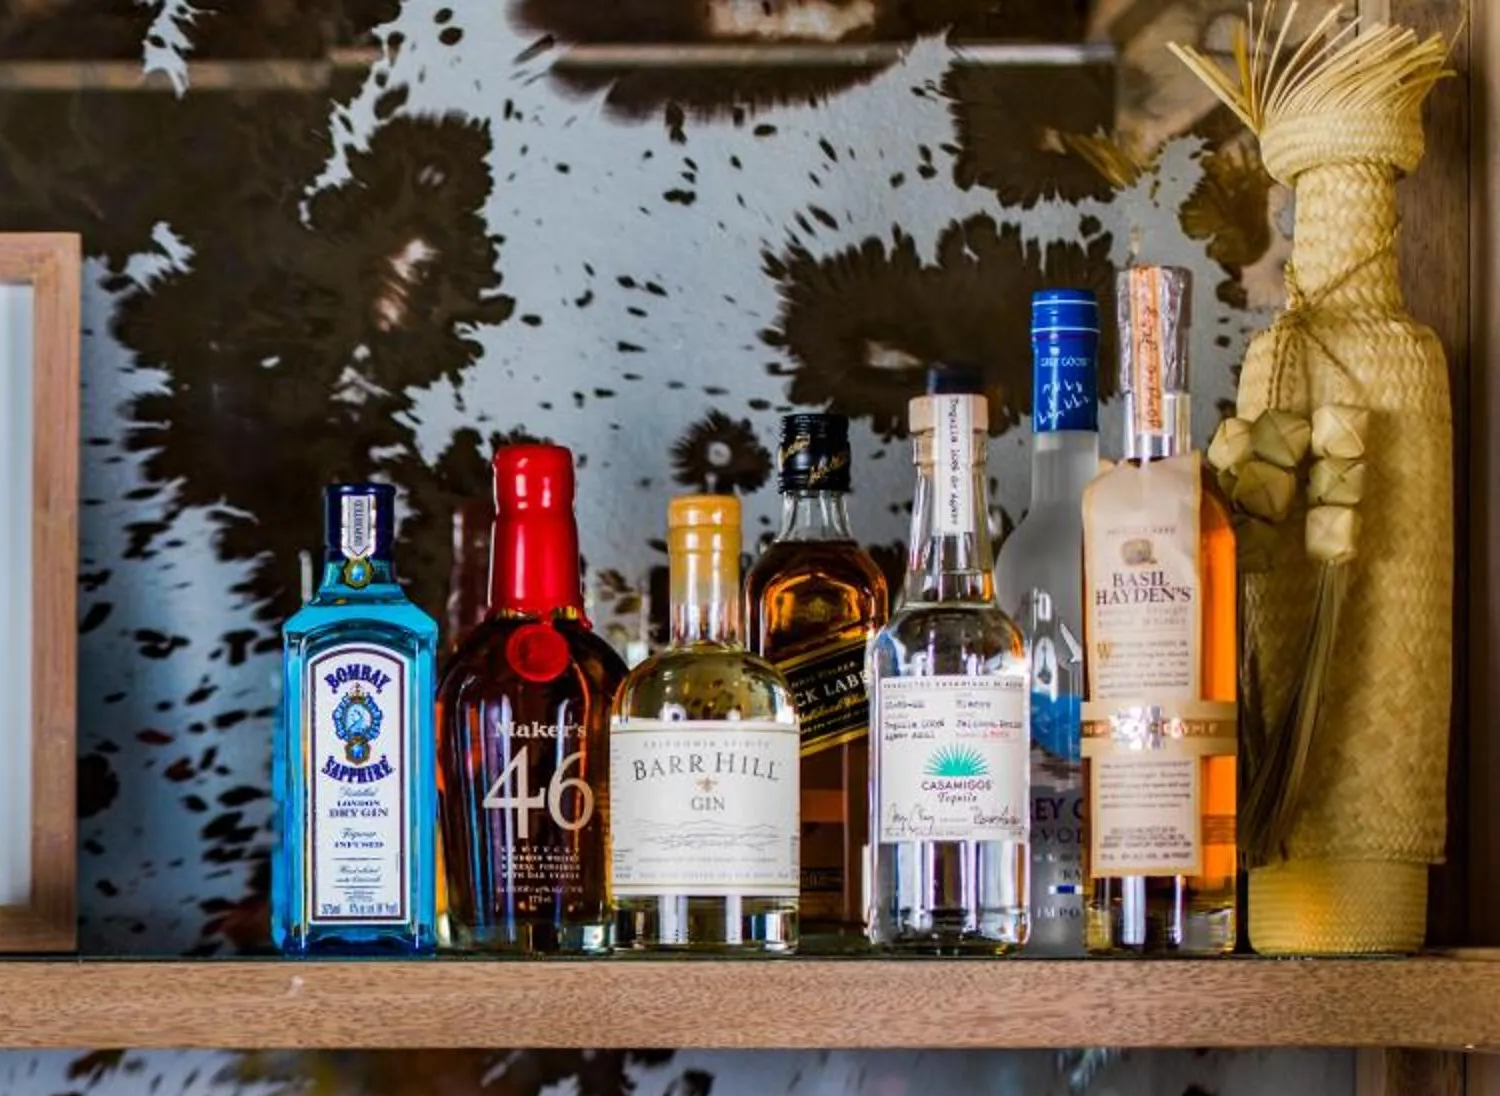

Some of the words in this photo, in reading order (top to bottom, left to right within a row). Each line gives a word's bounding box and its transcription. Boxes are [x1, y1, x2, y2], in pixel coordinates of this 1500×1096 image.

[1113, 571, 1170, 588] BASIL
[1096, 585, 1192, 605] HAYDEN'S
[324, 663, 392, 694] BOMBAY
[823, 669, 870, 697] LABE
[495, 720, 588, 738] Maker's
[322, 755, 394, 784] SAPPHIRE
[633, 753, 705, 782] BARR
[715, 751, 780, 781] HILL
[483, 746, 595, 839] 46
[922, 780, 992, 791] CASAMIGOS
[691, 796, 726, 811] GIN
[938, 792, 978, 805] Tequila
[329, 808, 359, 817] DRY
[361, 808, 388, 817] GIN
[1034, 798, 1066, 820] EY
[1037, 907, 1080, 918] IMPO
